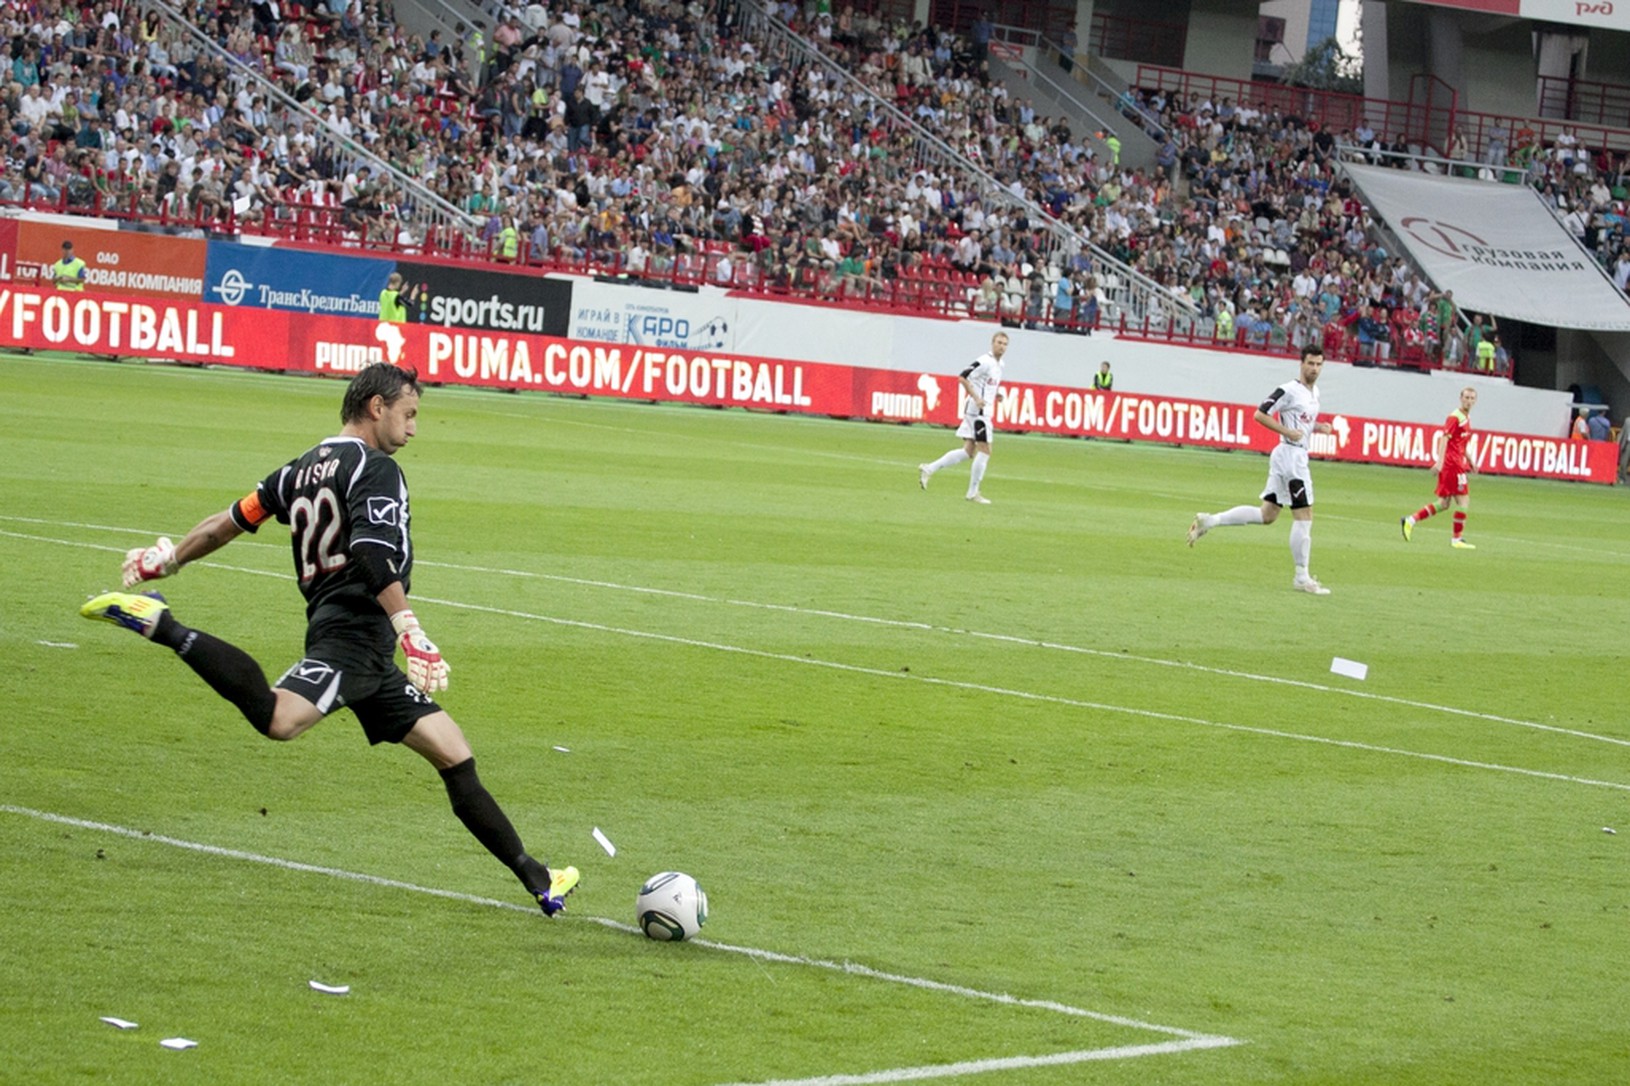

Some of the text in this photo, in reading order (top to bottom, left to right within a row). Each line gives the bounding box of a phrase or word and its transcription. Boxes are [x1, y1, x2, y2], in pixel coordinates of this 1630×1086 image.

[96, 251, 120, 265] ОАО
[127, 272, 203, 295] КОМПАНИЯ
[430, 295, 544, 331] sports.ru
[428, 332, 812, 407] PUMA.COM/FOOTBALL
[871, 391, 923, 419] PUMA
[1362, 421, 1592, 477] PUMA.CM/FOOTBALL
[290, 487, 347, 583] 22
